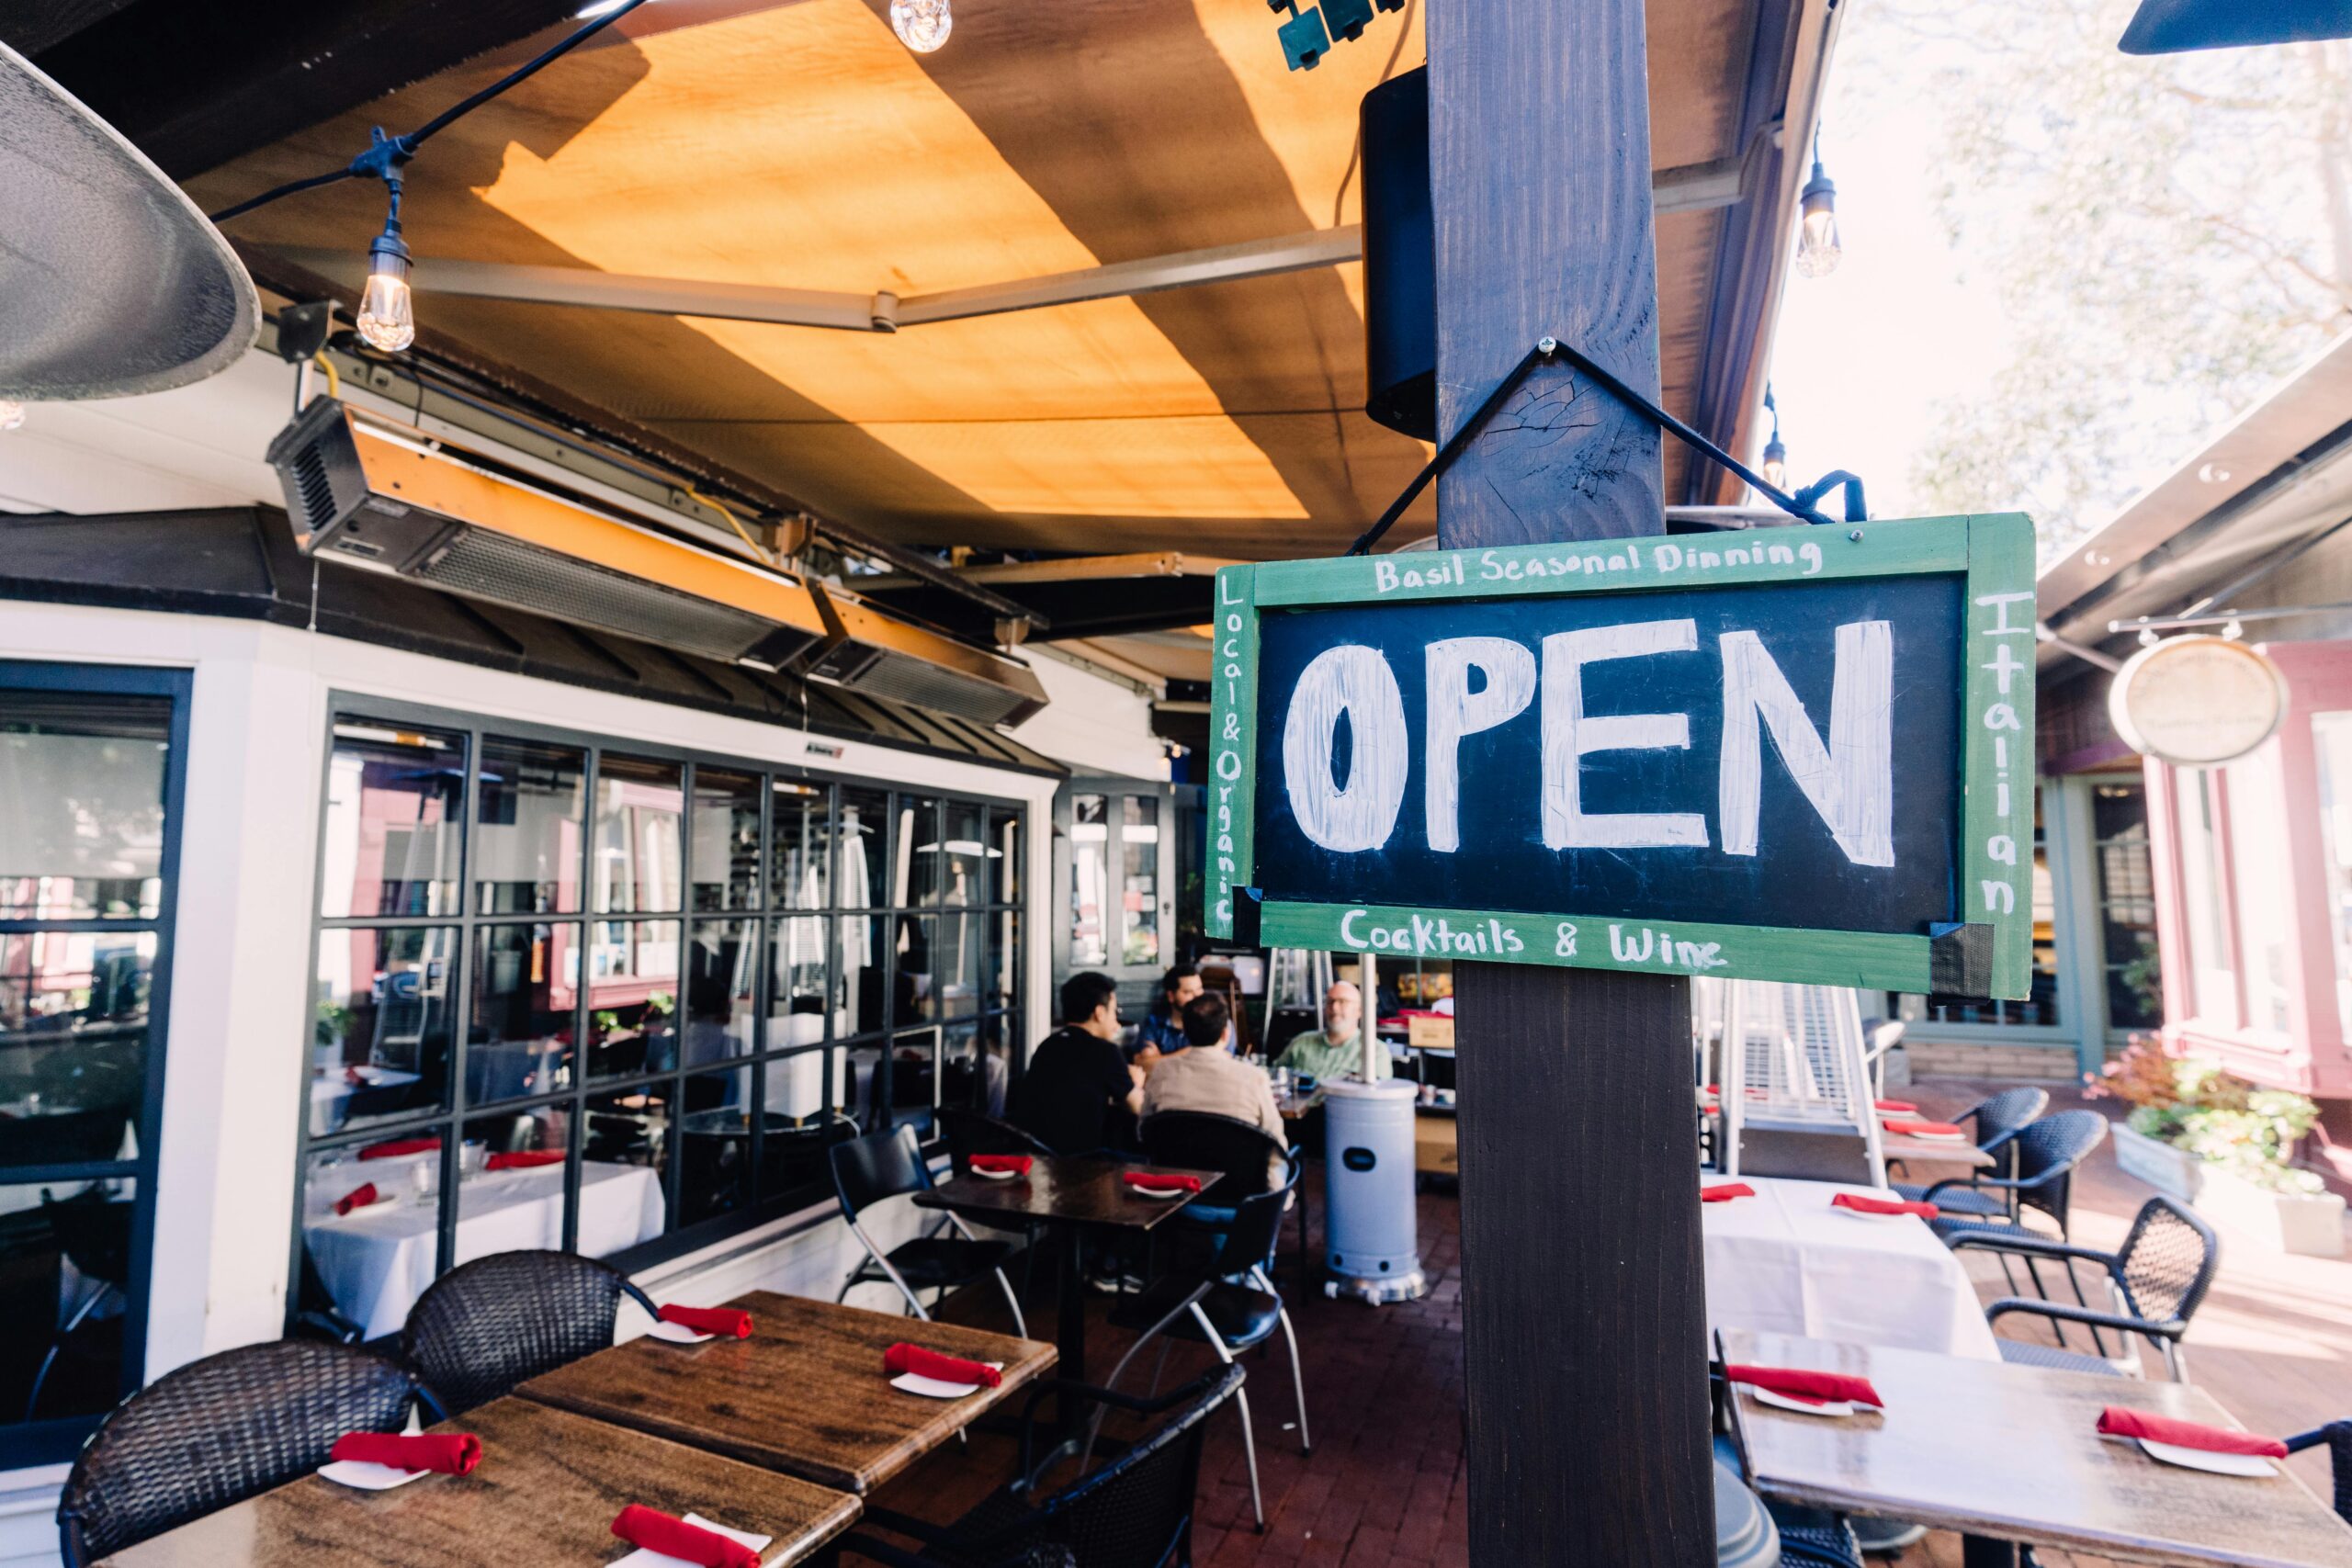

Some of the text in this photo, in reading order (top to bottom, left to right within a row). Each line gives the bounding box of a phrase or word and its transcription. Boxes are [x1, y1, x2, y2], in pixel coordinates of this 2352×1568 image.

[1374, 539, 1824, 594] Basil Seasonal Dinning
[1282, 617, 1896, 869] OPEN
[1973, 590, 2035, 917] Italian
[1340, 908, 1729, 969] Cocktails & Wine
